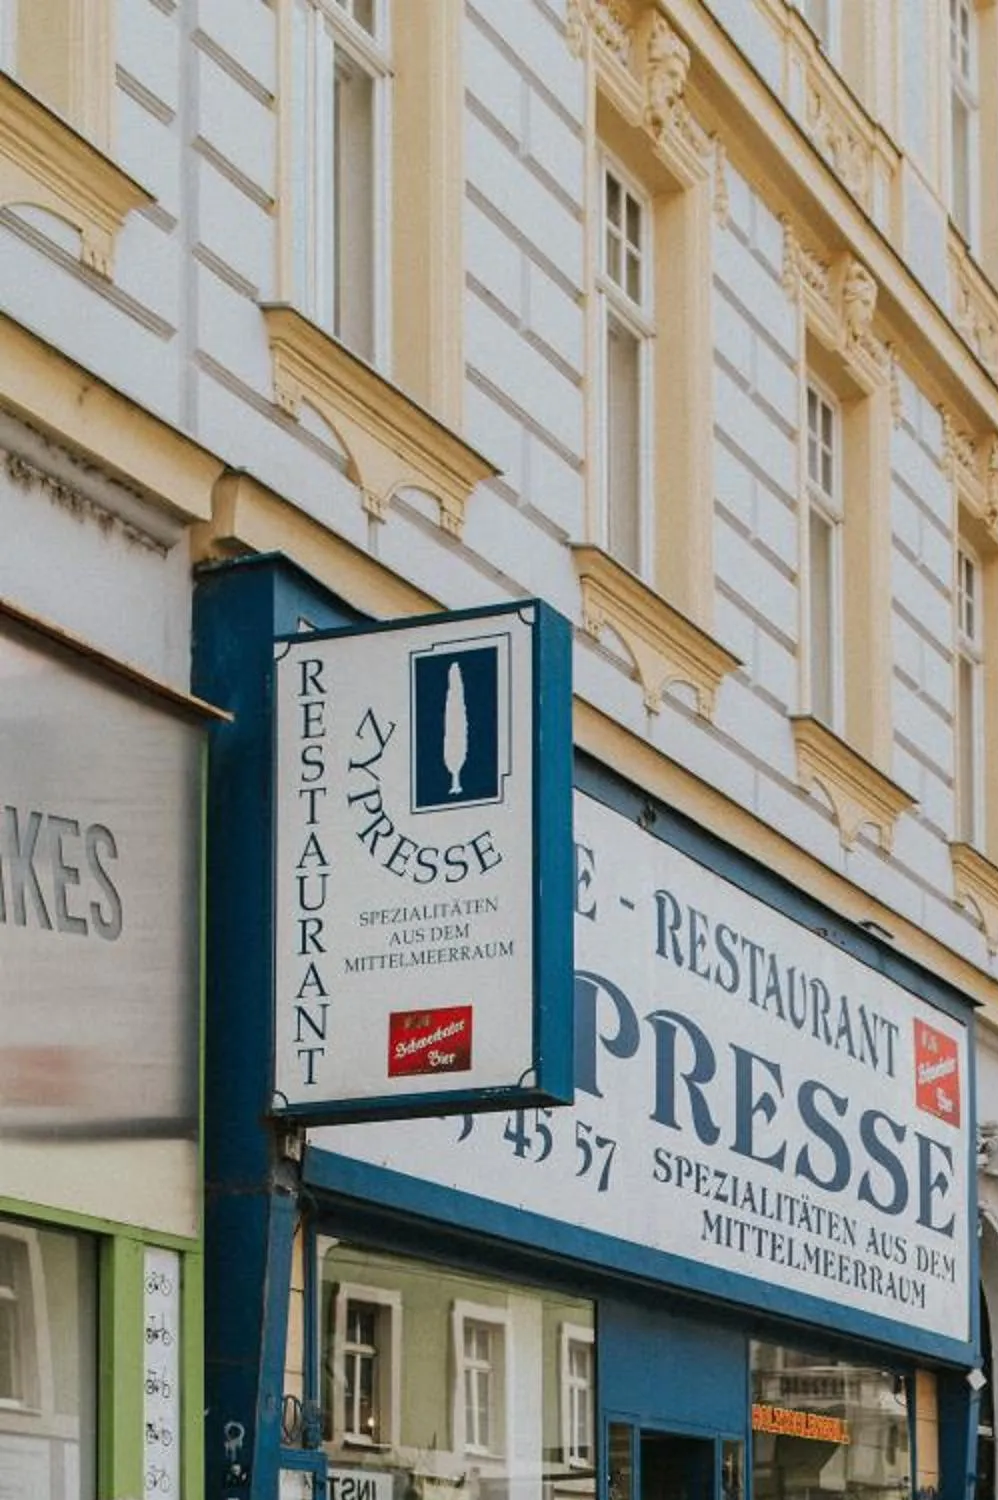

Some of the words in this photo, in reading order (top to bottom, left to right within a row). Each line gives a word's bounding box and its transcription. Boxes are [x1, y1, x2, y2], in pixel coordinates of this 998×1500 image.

[347, 707, 503, 884] ZYPRESSE
[295, 658, 331, 1086] RESTAURANT
[358, 896, 499, 928] SPEZIALITÄTEN
[343, 940, 514, 974] MITTELMEERRAUM
[388, 927, 426, 946] AUS
[430, 923, 470, 942] DEM
[655, 889, 899, 1079] RESTAURANT
[427, 1050, 457, 1068] Bier
[575, 1120, 617, 1193] 57
[653, 1147, 857, 1248] SPEZIALITÄTEN
[866, 1227, 907, 1265] AUS
[916, 1245, 956, 1284] DEM
[701, 1209, 926, 1309] MITTELMEERRAUM
